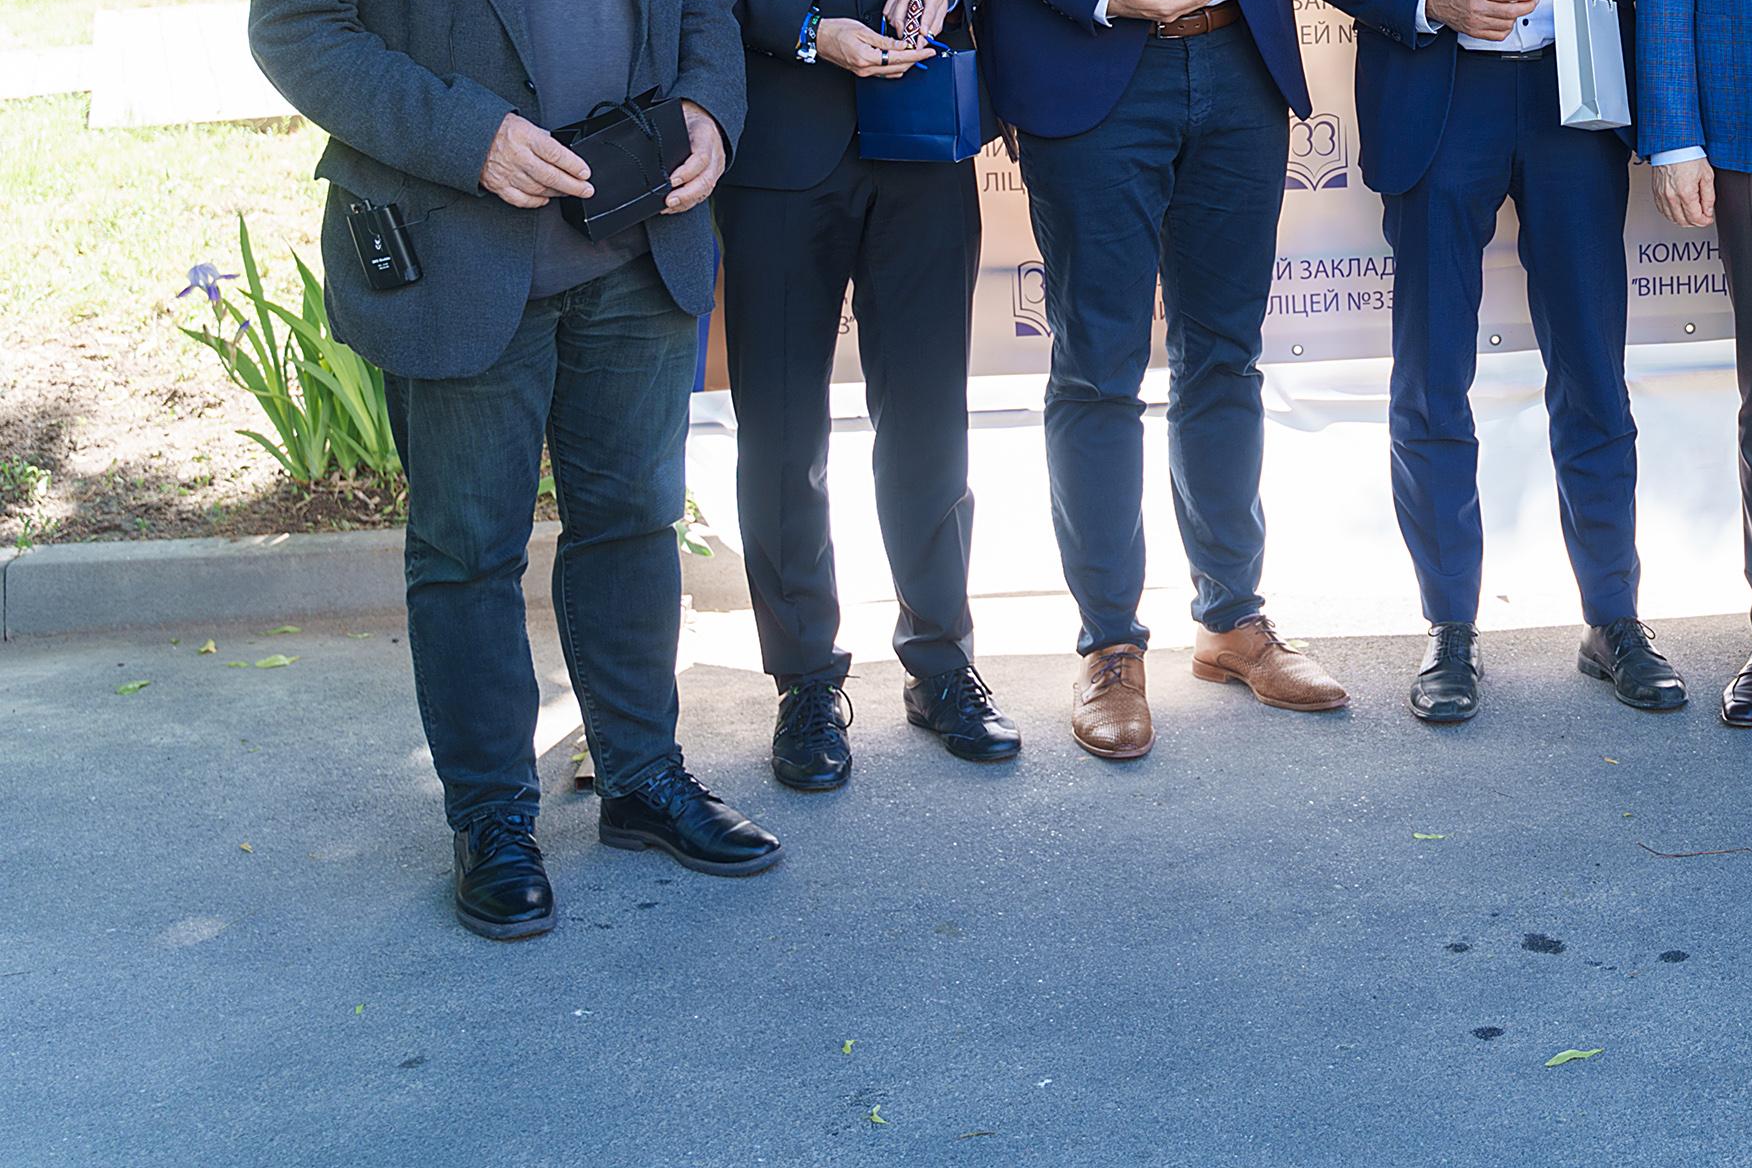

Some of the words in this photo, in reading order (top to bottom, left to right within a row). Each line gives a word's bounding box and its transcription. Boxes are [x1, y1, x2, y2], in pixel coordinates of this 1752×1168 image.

[983, 171, 1026, 195] ЛІЦ
[1639, 241, 1722, 264] КОМУН
[1631, 274, 1728, 297] "ВІННИЦ
[1267, 289, 1340, 317] ЛІЦЕЙ
[1348, 291, 1394, 311] №3
